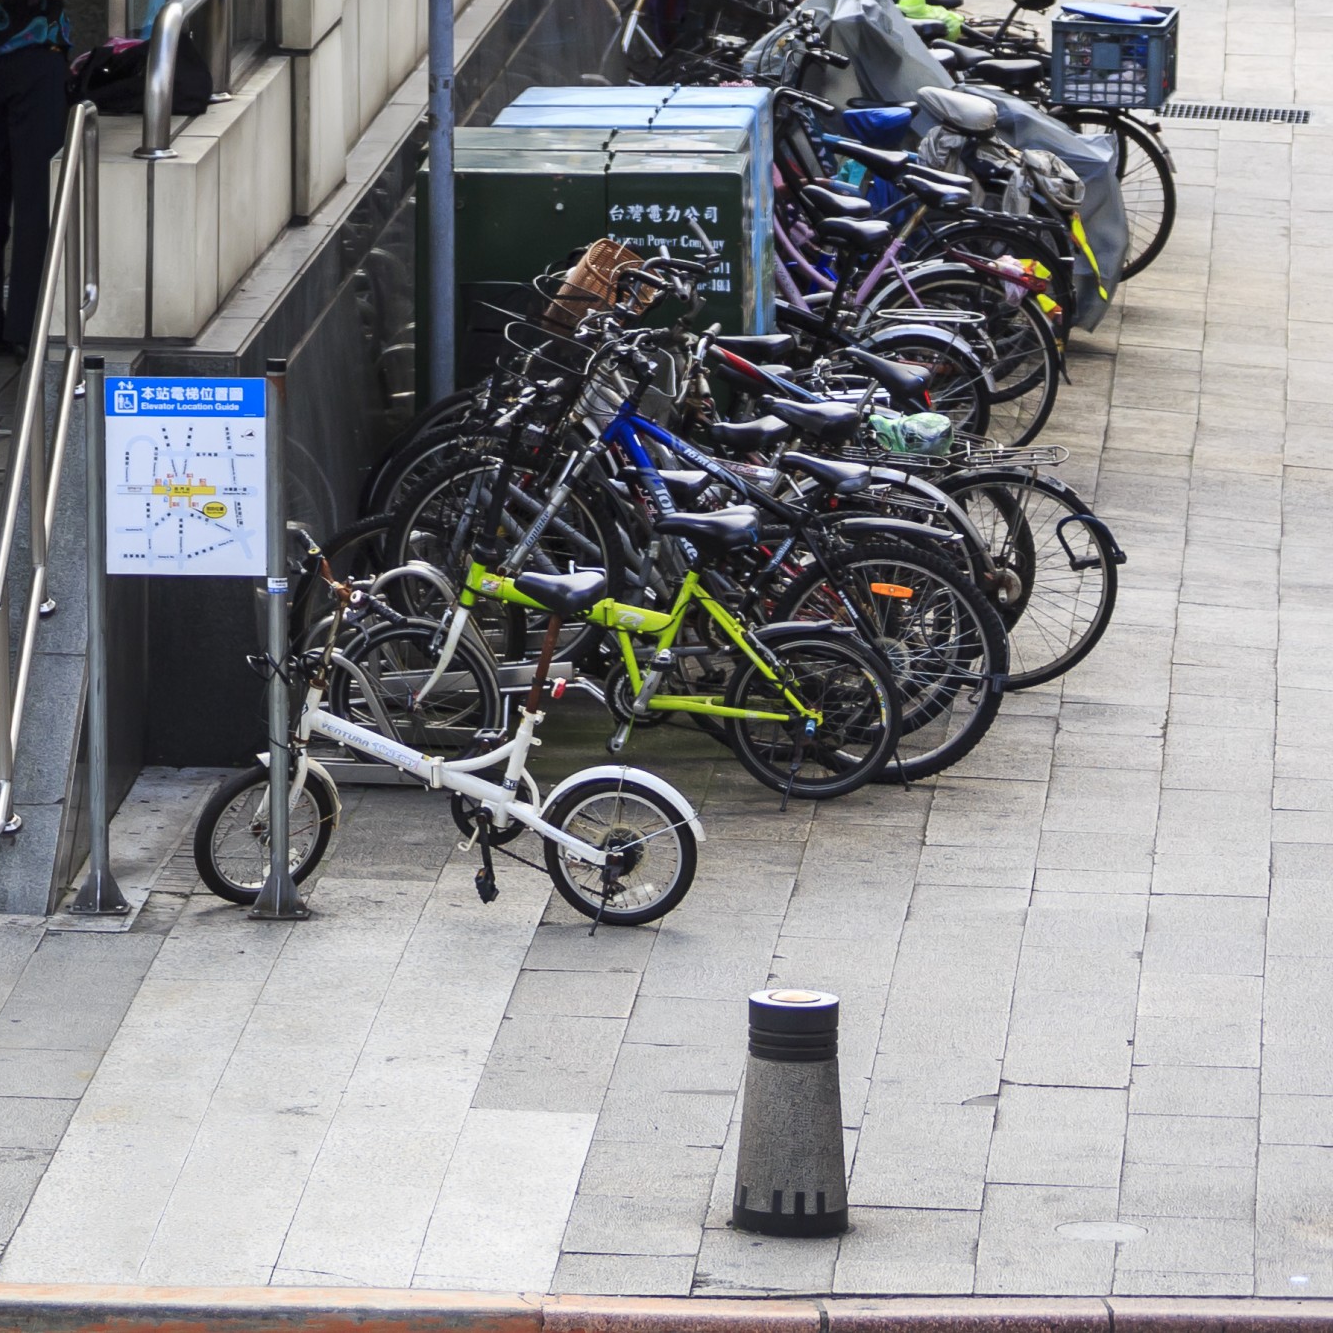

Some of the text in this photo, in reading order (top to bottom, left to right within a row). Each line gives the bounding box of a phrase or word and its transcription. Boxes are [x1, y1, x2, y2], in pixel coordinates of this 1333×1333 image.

[608, 204, 719, 224] 台灣電力公司
[140, 386, 244, 402] 本站電梯位置圖
[140, 401, 240, 411] Elevator Location Guide
